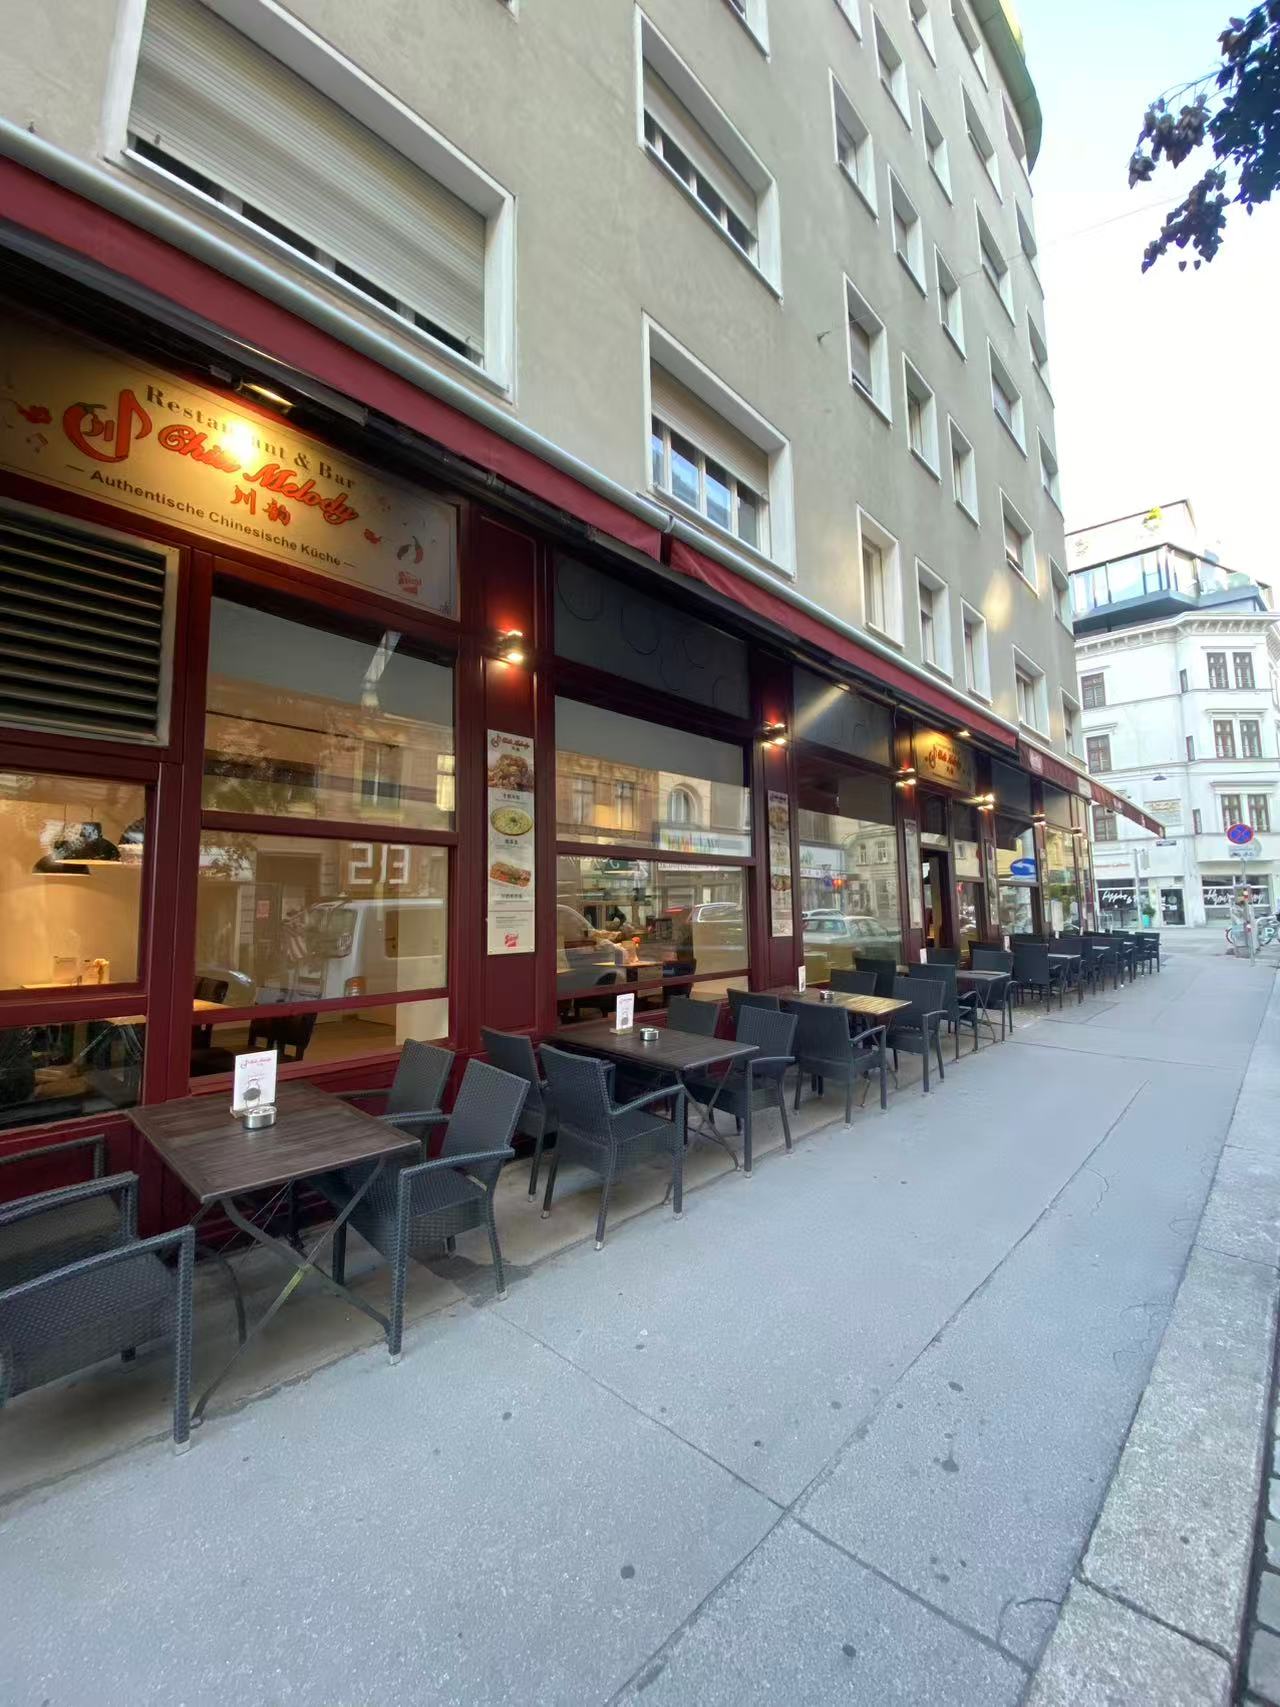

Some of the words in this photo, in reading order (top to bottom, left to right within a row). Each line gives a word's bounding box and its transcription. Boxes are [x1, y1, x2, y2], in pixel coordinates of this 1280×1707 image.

[146, 384, 285, 460] Restauant
[294, 452, 311, 471] &
[319, 461, 356, 489] Bar
[90, 469, 205, 518] Authentische
[208, 510, 298, 551] Chinesische
[301, 543, 341, 567] Küche
[242, 463, 360, 525] Melody
